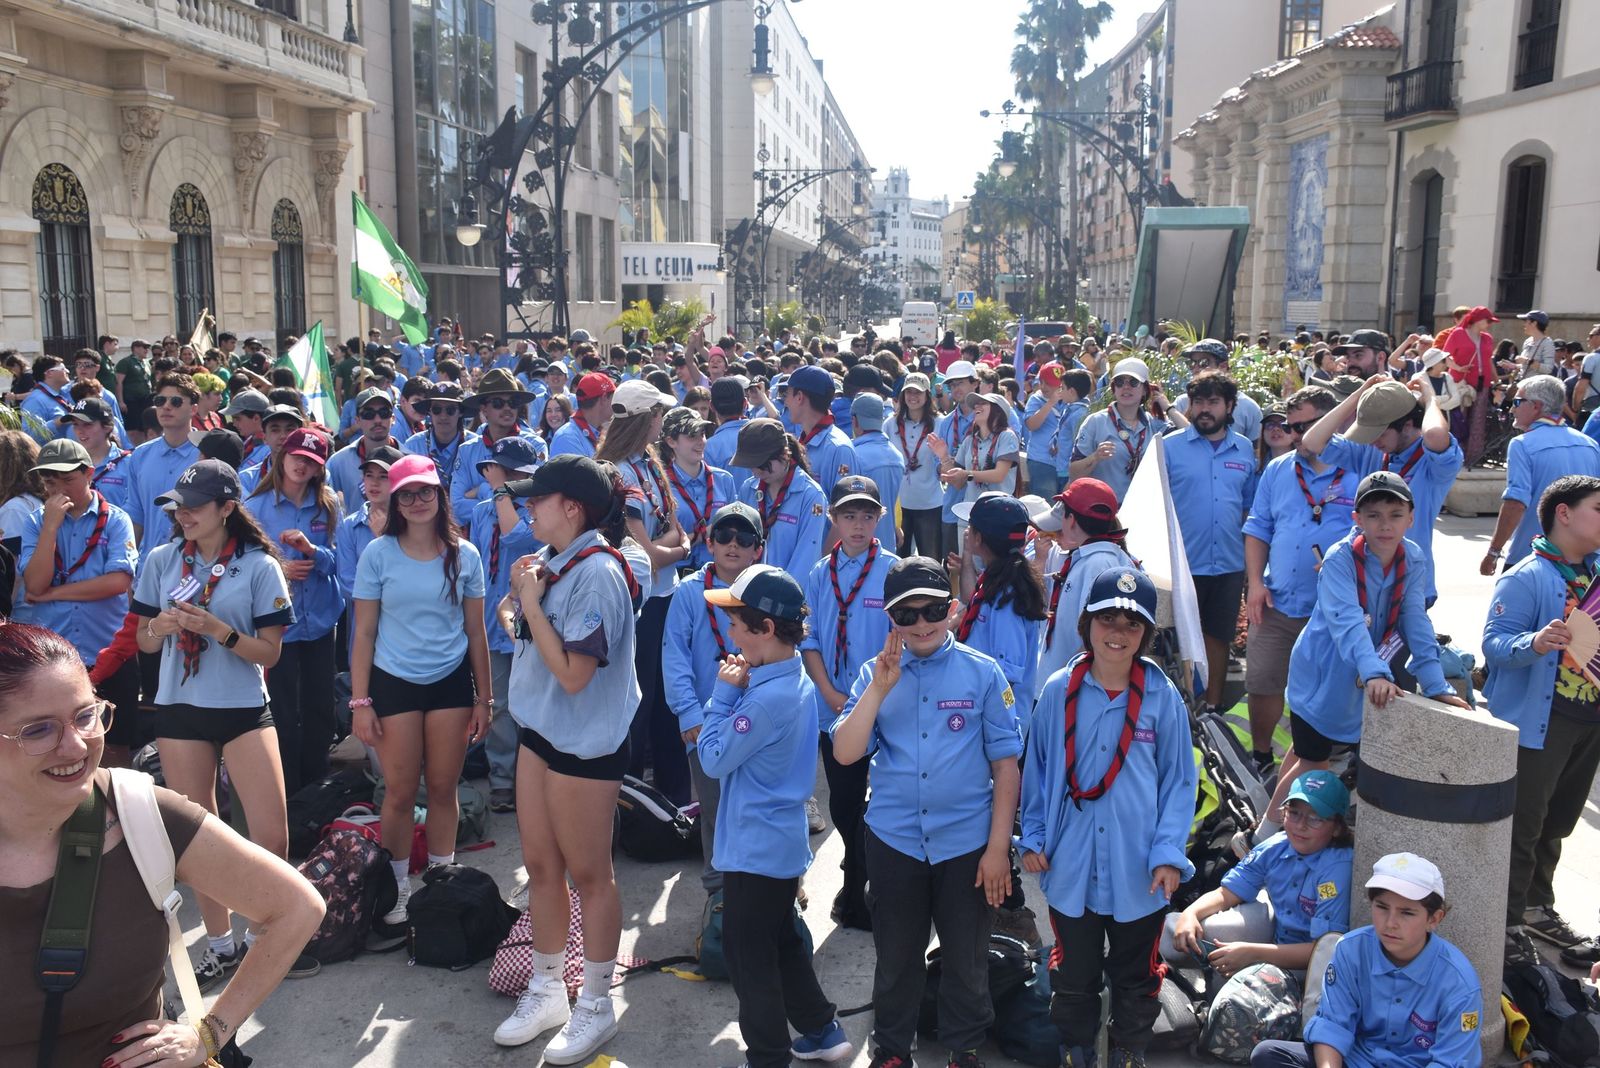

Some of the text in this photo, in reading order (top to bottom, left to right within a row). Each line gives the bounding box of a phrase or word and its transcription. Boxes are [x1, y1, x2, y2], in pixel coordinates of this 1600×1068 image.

[656, 257, 693, 276] CEUTA
[302, 433, 319, 450] K
[180, 468, 197, 484] NY
